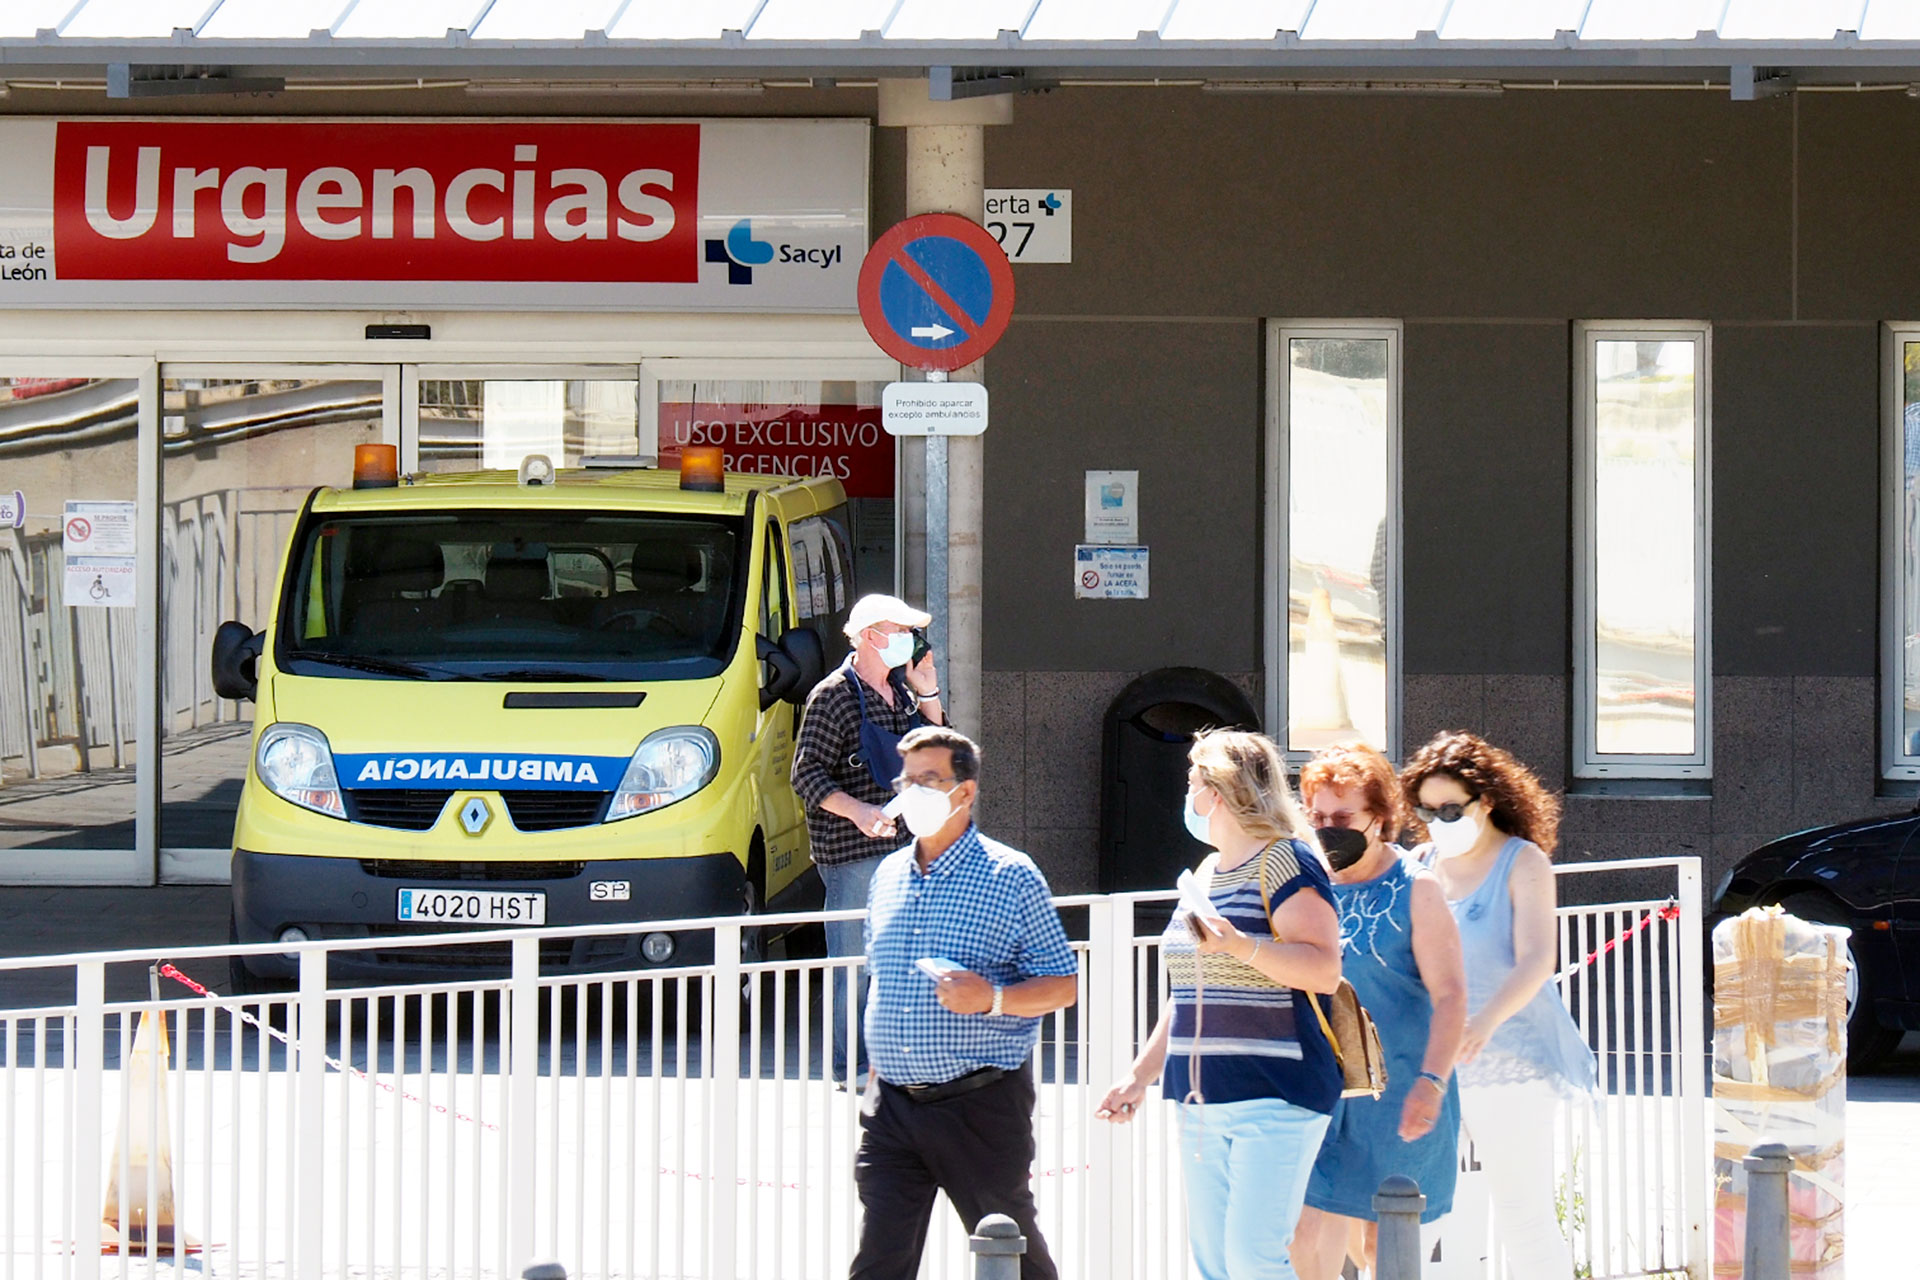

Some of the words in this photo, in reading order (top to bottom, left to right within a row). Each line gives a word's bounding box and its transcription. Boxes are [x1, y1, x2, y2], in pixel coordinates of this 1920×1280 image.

[83, 144, 676, 264] Urgencias
[986, 195, 1030, 214] erta
[0, 244, 16, 259] ta
[22, 242, 46, 259] de
[779, 244, 841, 269] Sacyl
[1, 262, 47, 280] León
[895, 399, 938, 408] Prohibido
[939, 400, 973, 409] aparcar
[888, 411, 923, 420] excepto
[925, 410, 981, 419] ambulancias
[674, 420, 727, 445] USO
[735, 421, 879, 447] EXCLUSIVO
[723, 454, 851, 480] RGENCIAS
[593, 883, 629, 899] SP
[416, 893, 481, 919] 4020
[490, 895, 538, 920] HST
